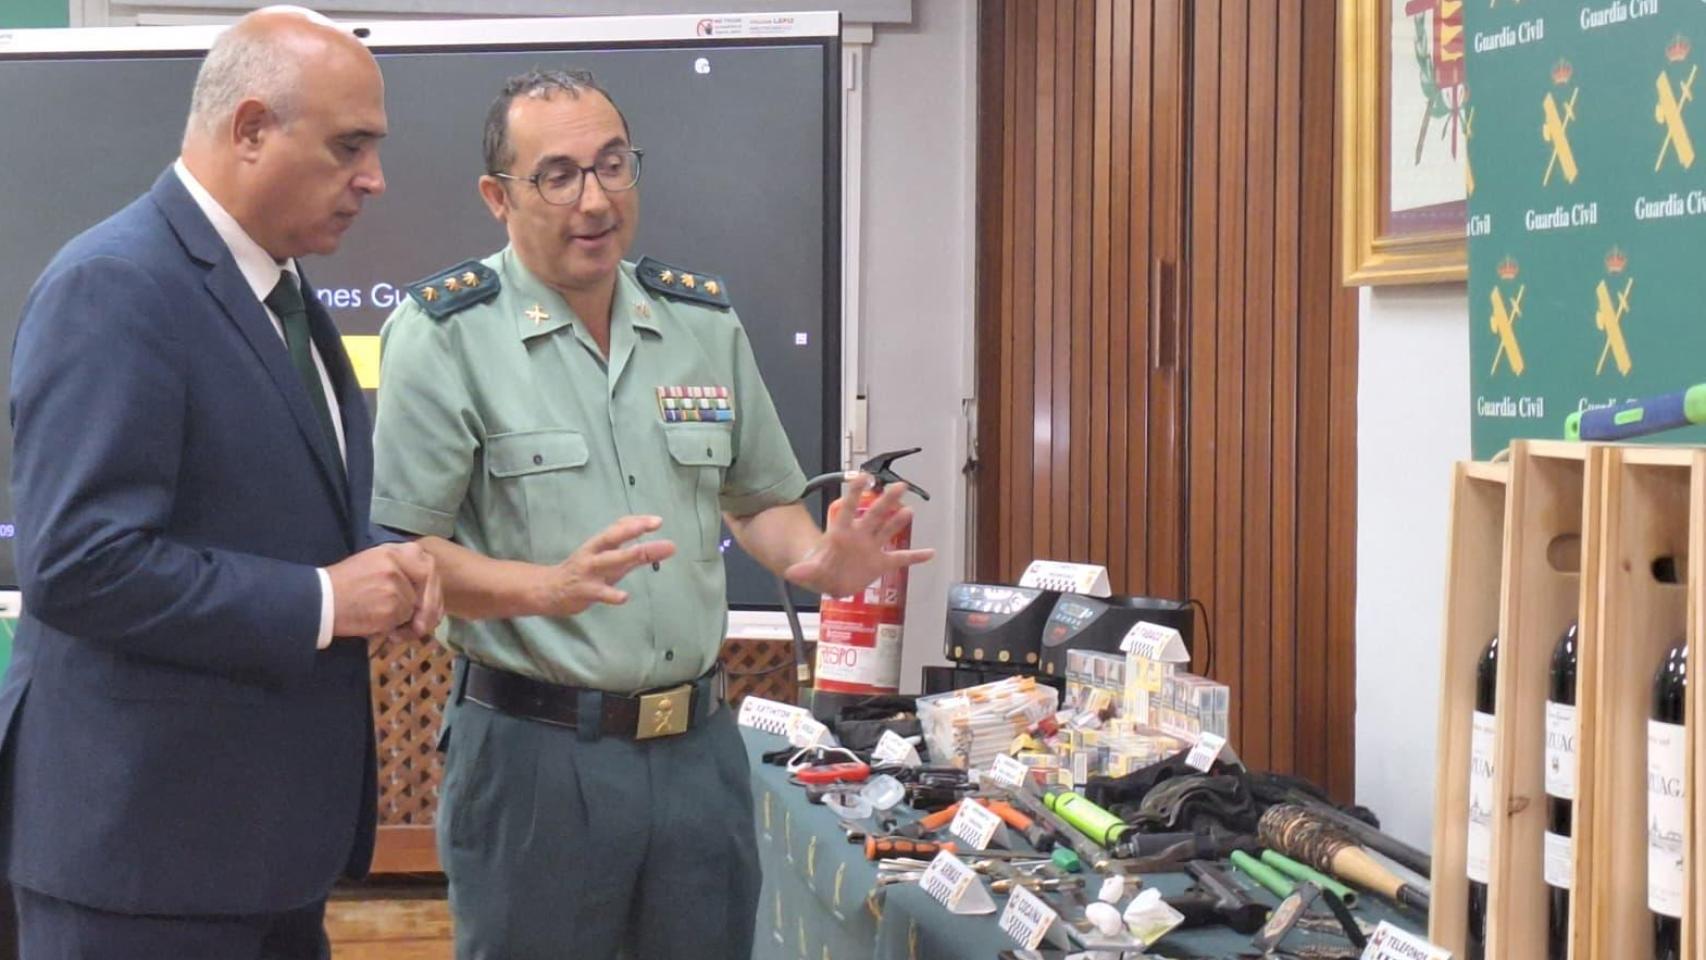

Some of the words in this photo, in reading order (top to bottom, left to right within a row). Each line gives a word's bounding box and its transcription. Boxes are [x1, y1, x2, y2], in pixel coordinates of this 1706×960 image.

[1580, 4, 1627, 30] Guardia
[1629, 0, 1659, 19] Civil
[1474, 26, 1516, 53] Guardia
[1518, 18, 1544, 44] Civil
[1525, 205, 1570, 231] Guardia
[1571, 202, 1597, 226] Civil
[1634, 192, 1684, 220] Guardia
[1470, 213, 1491, 236] Civil
[317, 287, 362, 307] nes
[1477, 395, 1517, 417] Guardia
[1519, 396, 1544, 418] Civil
